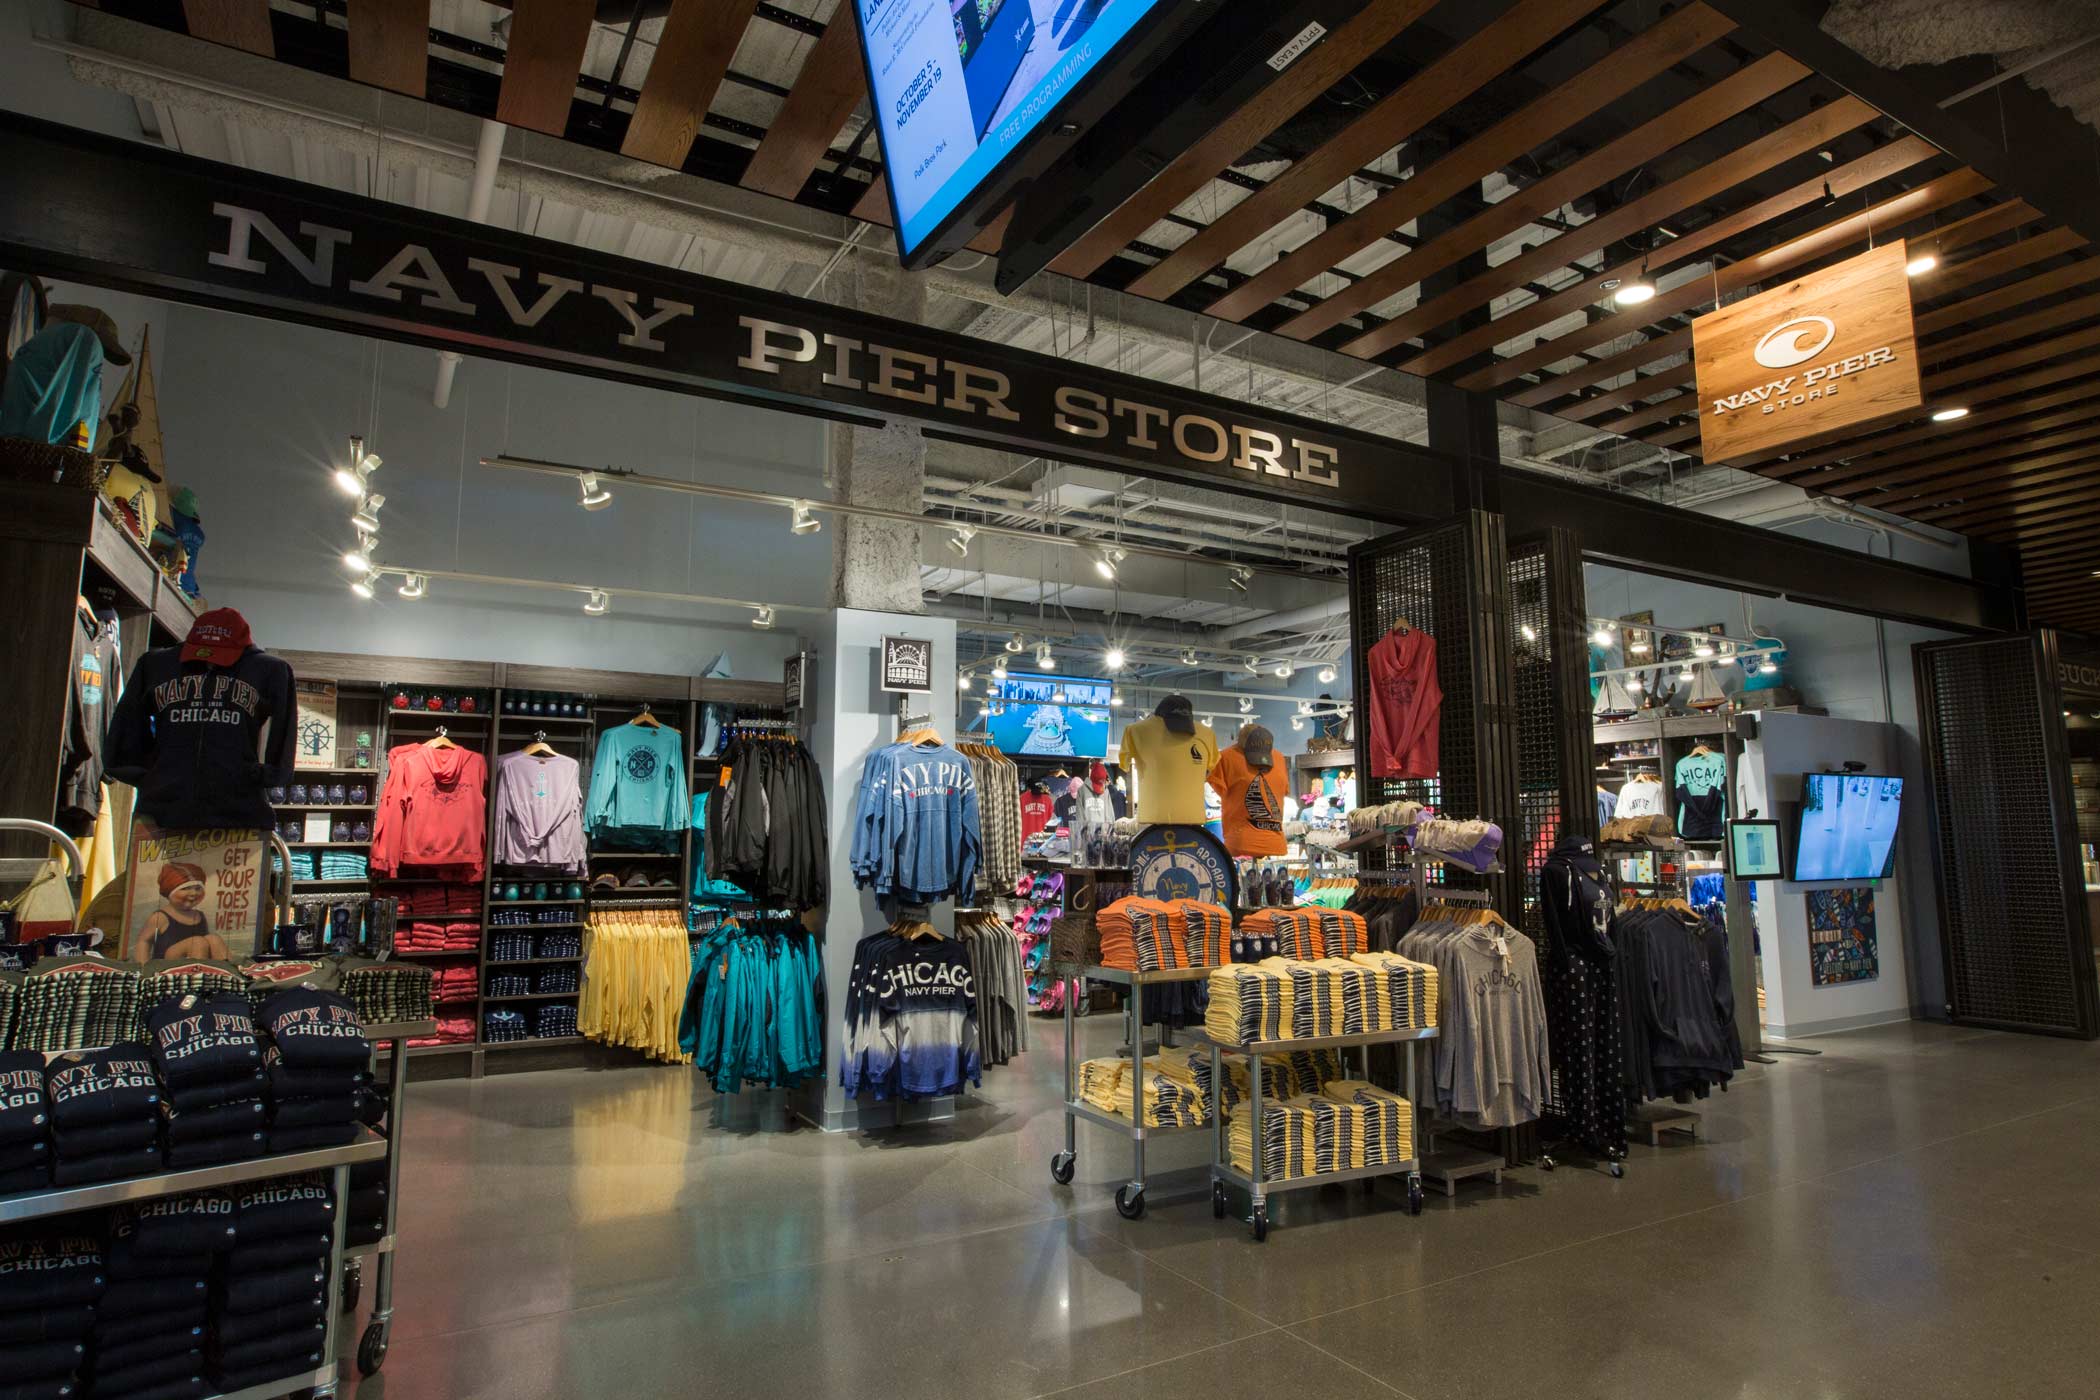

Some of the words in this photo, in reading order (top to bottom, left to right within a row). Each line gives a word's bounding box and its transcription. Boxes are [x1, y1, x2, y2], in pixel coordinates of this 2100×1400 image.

[1299, 26, 1321, 46] FPTV
[1273, 49, 1294, 68] EAST
[896, 68, 927, 113] OCTOBER
[926, 60, 933, 74] 5
[999, 117, 1021, 148] FREE
[1021, 42, 1092, 123] PROGRAMMING
[896, 78, 934, 131] NOVEMBER
[933, 67, 942, 84] 19
[935, 138, 947, 156] Park
[207, 201, 695, 352] NAVY
[736, 315, 1020, 422] PIER
[1053, 386, 1340, 488] STORE
[1713, 376, 1797, 415] NAVY
[1803, 346, 1897, 388] PIER
[1762, 384, 1839, 415] STORE
[154, 673, 208, 713] NAVY
[170, 709, 241, 725] CHICAGO
[140, 828, 259, 863] WELCOME
[223, 848, 250, 866] GET
[216, 868, 255, 889] YOUR
[1196, 847, 1226, 888] ABOARD
[216, 890, 249, 910] TOES
[215, 911, 248, 931] WET!
[880, 962, 976, 998] CHICAGO
[904, 987, 930, 997] NAVY
[932, 986, 956, 996] PIER
[286, 1024, 365, 1038] CHICAGO
[165, 1036, 255, 1060] CHICAGO
[56, 1075, 156, 1103] CHICAGO
[138, 1199, 234, 1219] CHICAGO
[239, 1186, 328, 1209] CHICAGO
